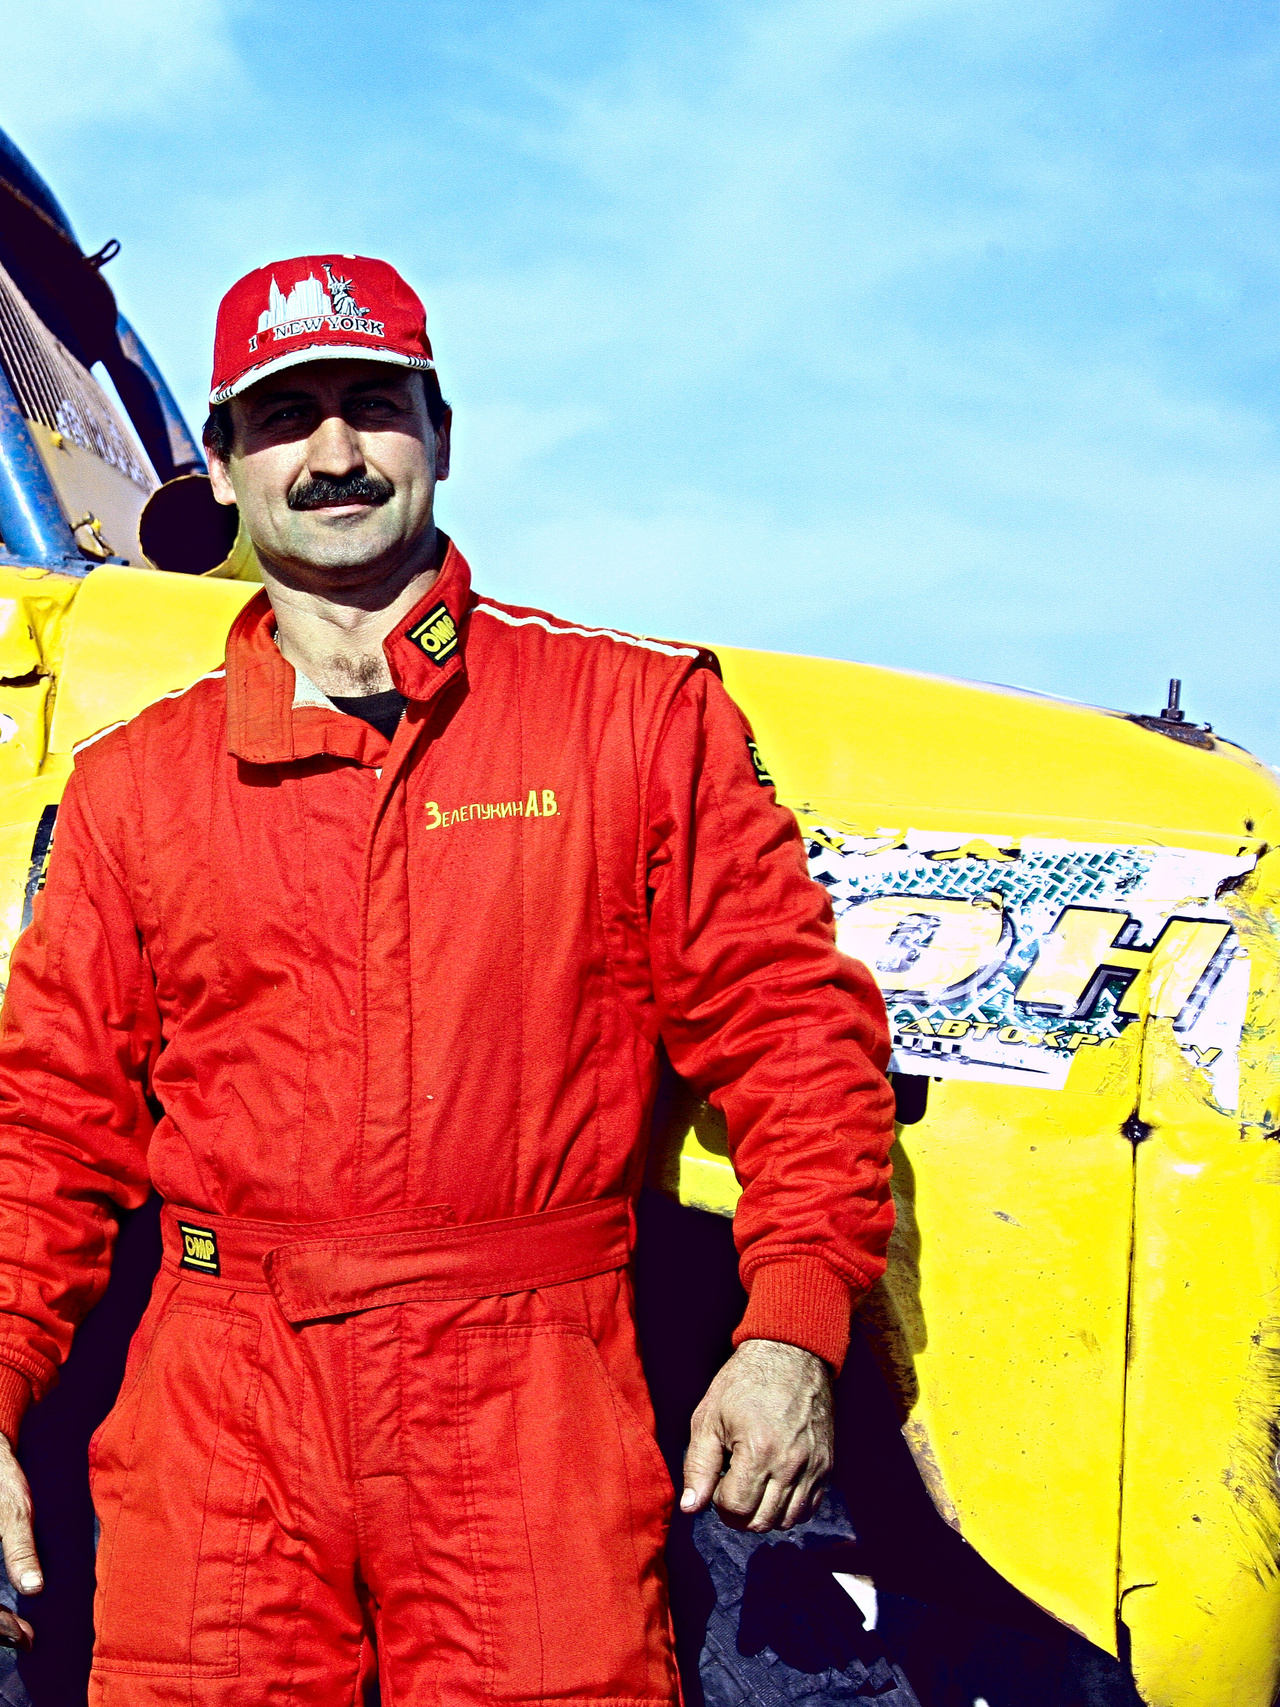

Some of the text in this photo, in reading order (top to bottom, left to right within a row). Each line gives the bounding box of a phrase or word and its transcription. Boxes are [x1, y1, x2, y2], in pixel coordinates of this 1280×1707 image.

[273, 317, 325, 341] NEW
[326, 316, 385, 337] YORK
[421, 615, 456, 652] OMP
[185, 1234, 215, 1261] OMP
